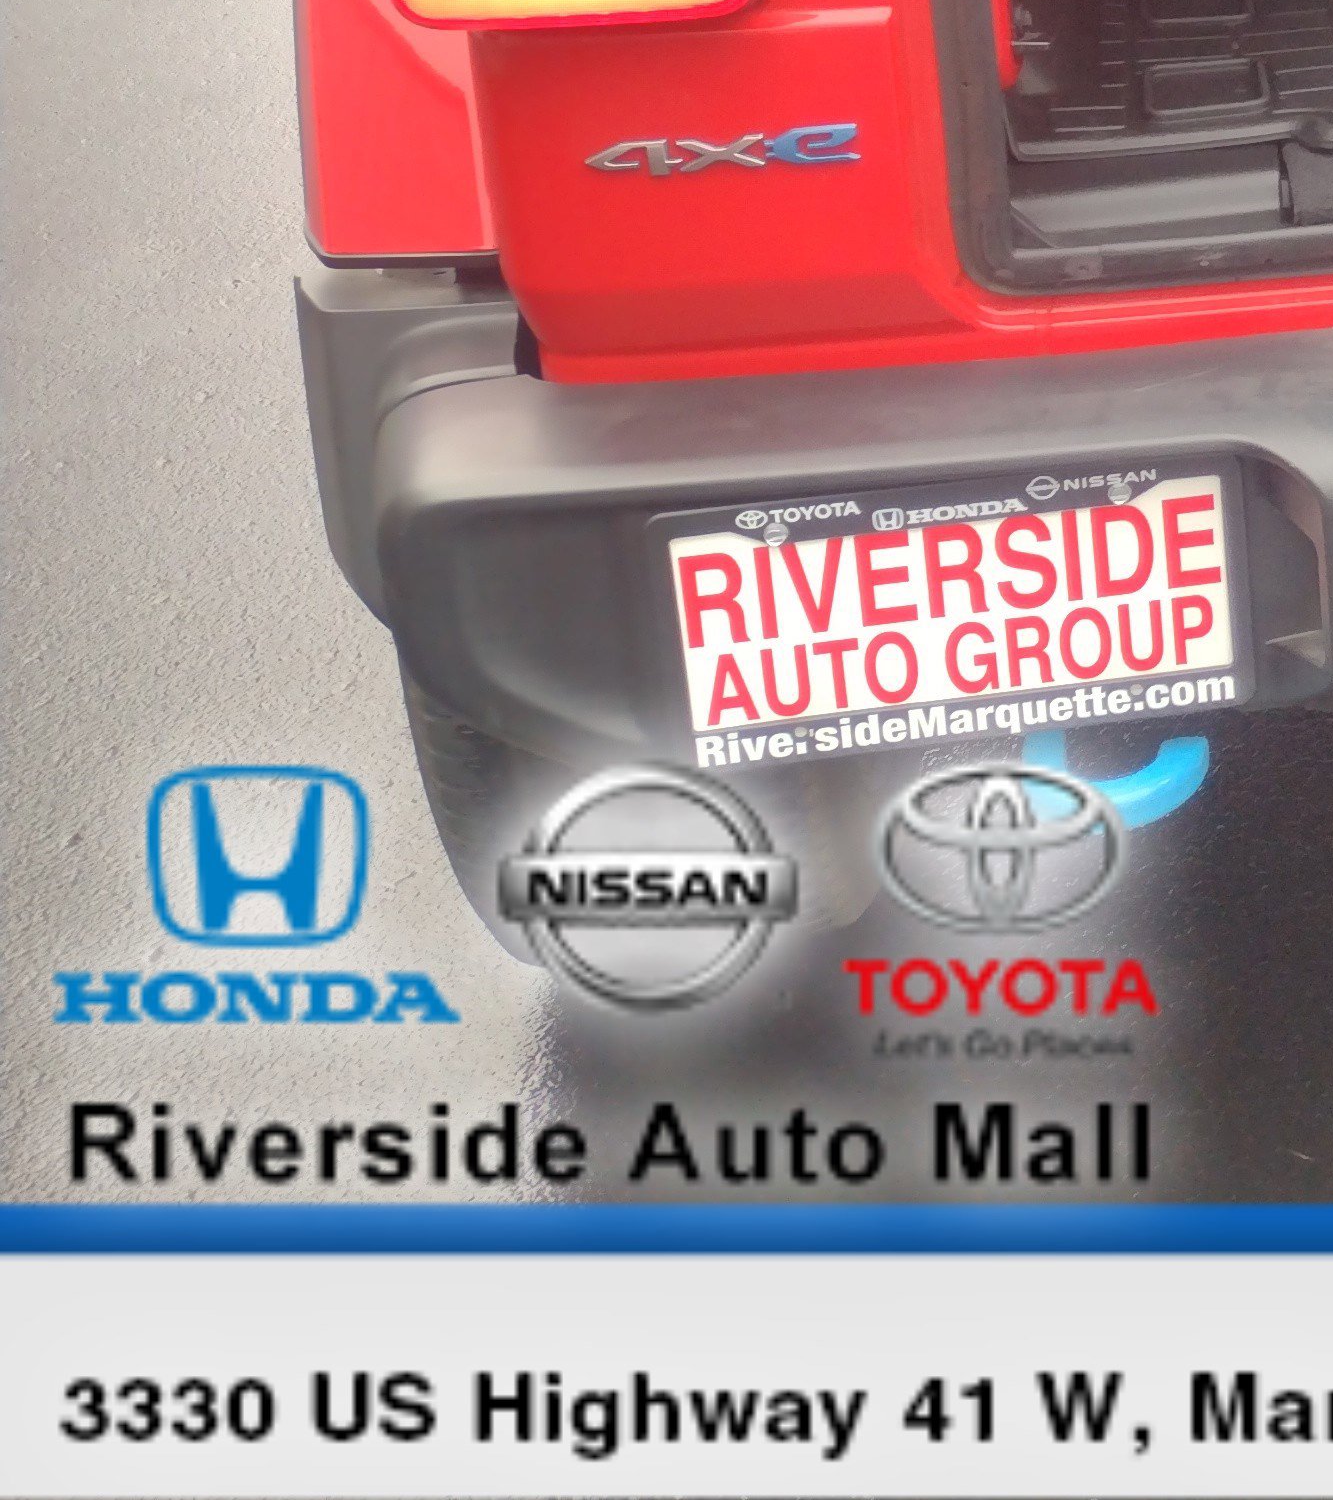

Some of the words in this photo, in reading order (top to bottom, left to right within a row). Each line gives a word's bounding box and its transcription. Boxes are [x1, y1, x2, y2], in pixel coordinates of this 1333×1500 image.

[1063, 468, 1157, 492] NISSAN
[768, 500, 862, 524] TOYOTA
[906, 497, 1028, 526] HONDA
[676, 492, 1223, 650] RIVERSIDE
[706, 629, 919, 727] AUTO
[944, 594, 1215, 697] GROUP
